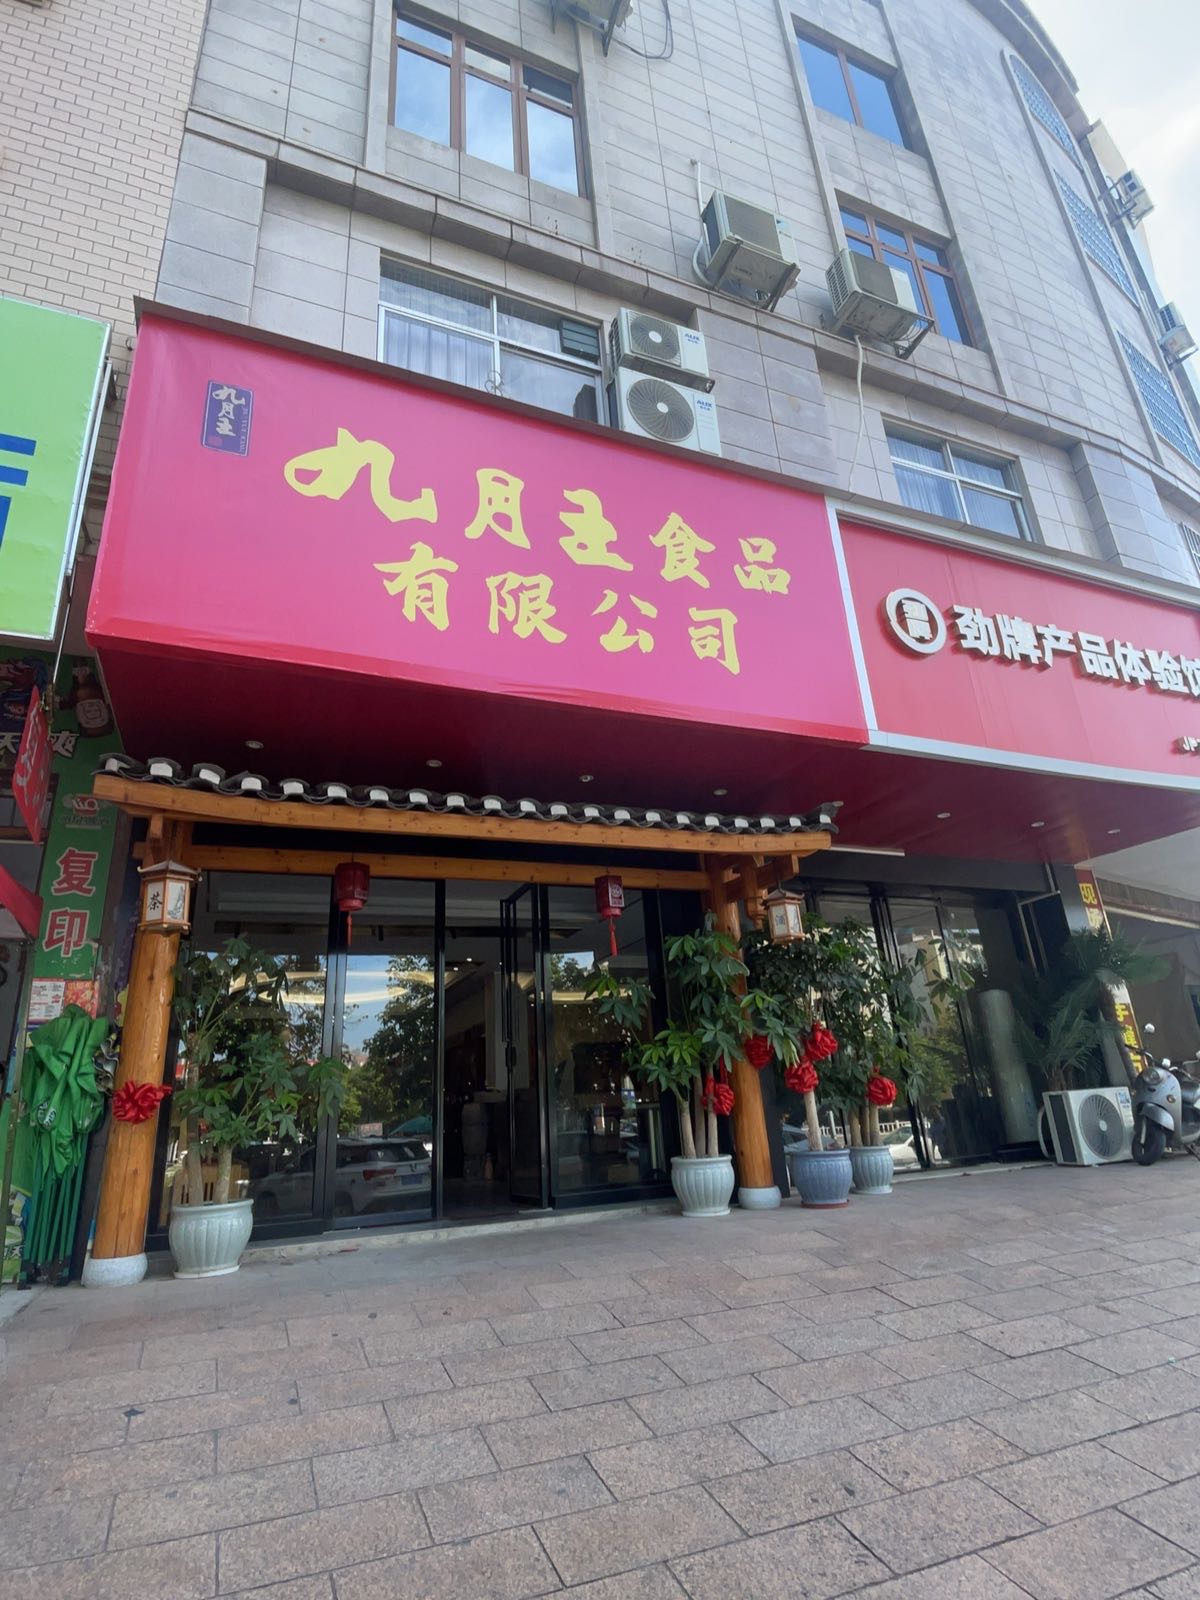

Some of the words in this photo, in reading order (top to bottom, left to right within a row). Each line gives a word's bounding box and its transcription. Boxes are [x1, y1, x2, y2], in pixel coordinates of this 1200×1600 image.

[697, 400, 712, 408] AUX
[373, 542, 741, 676] 有限公司
[42, 847, 99, 958] 复印
